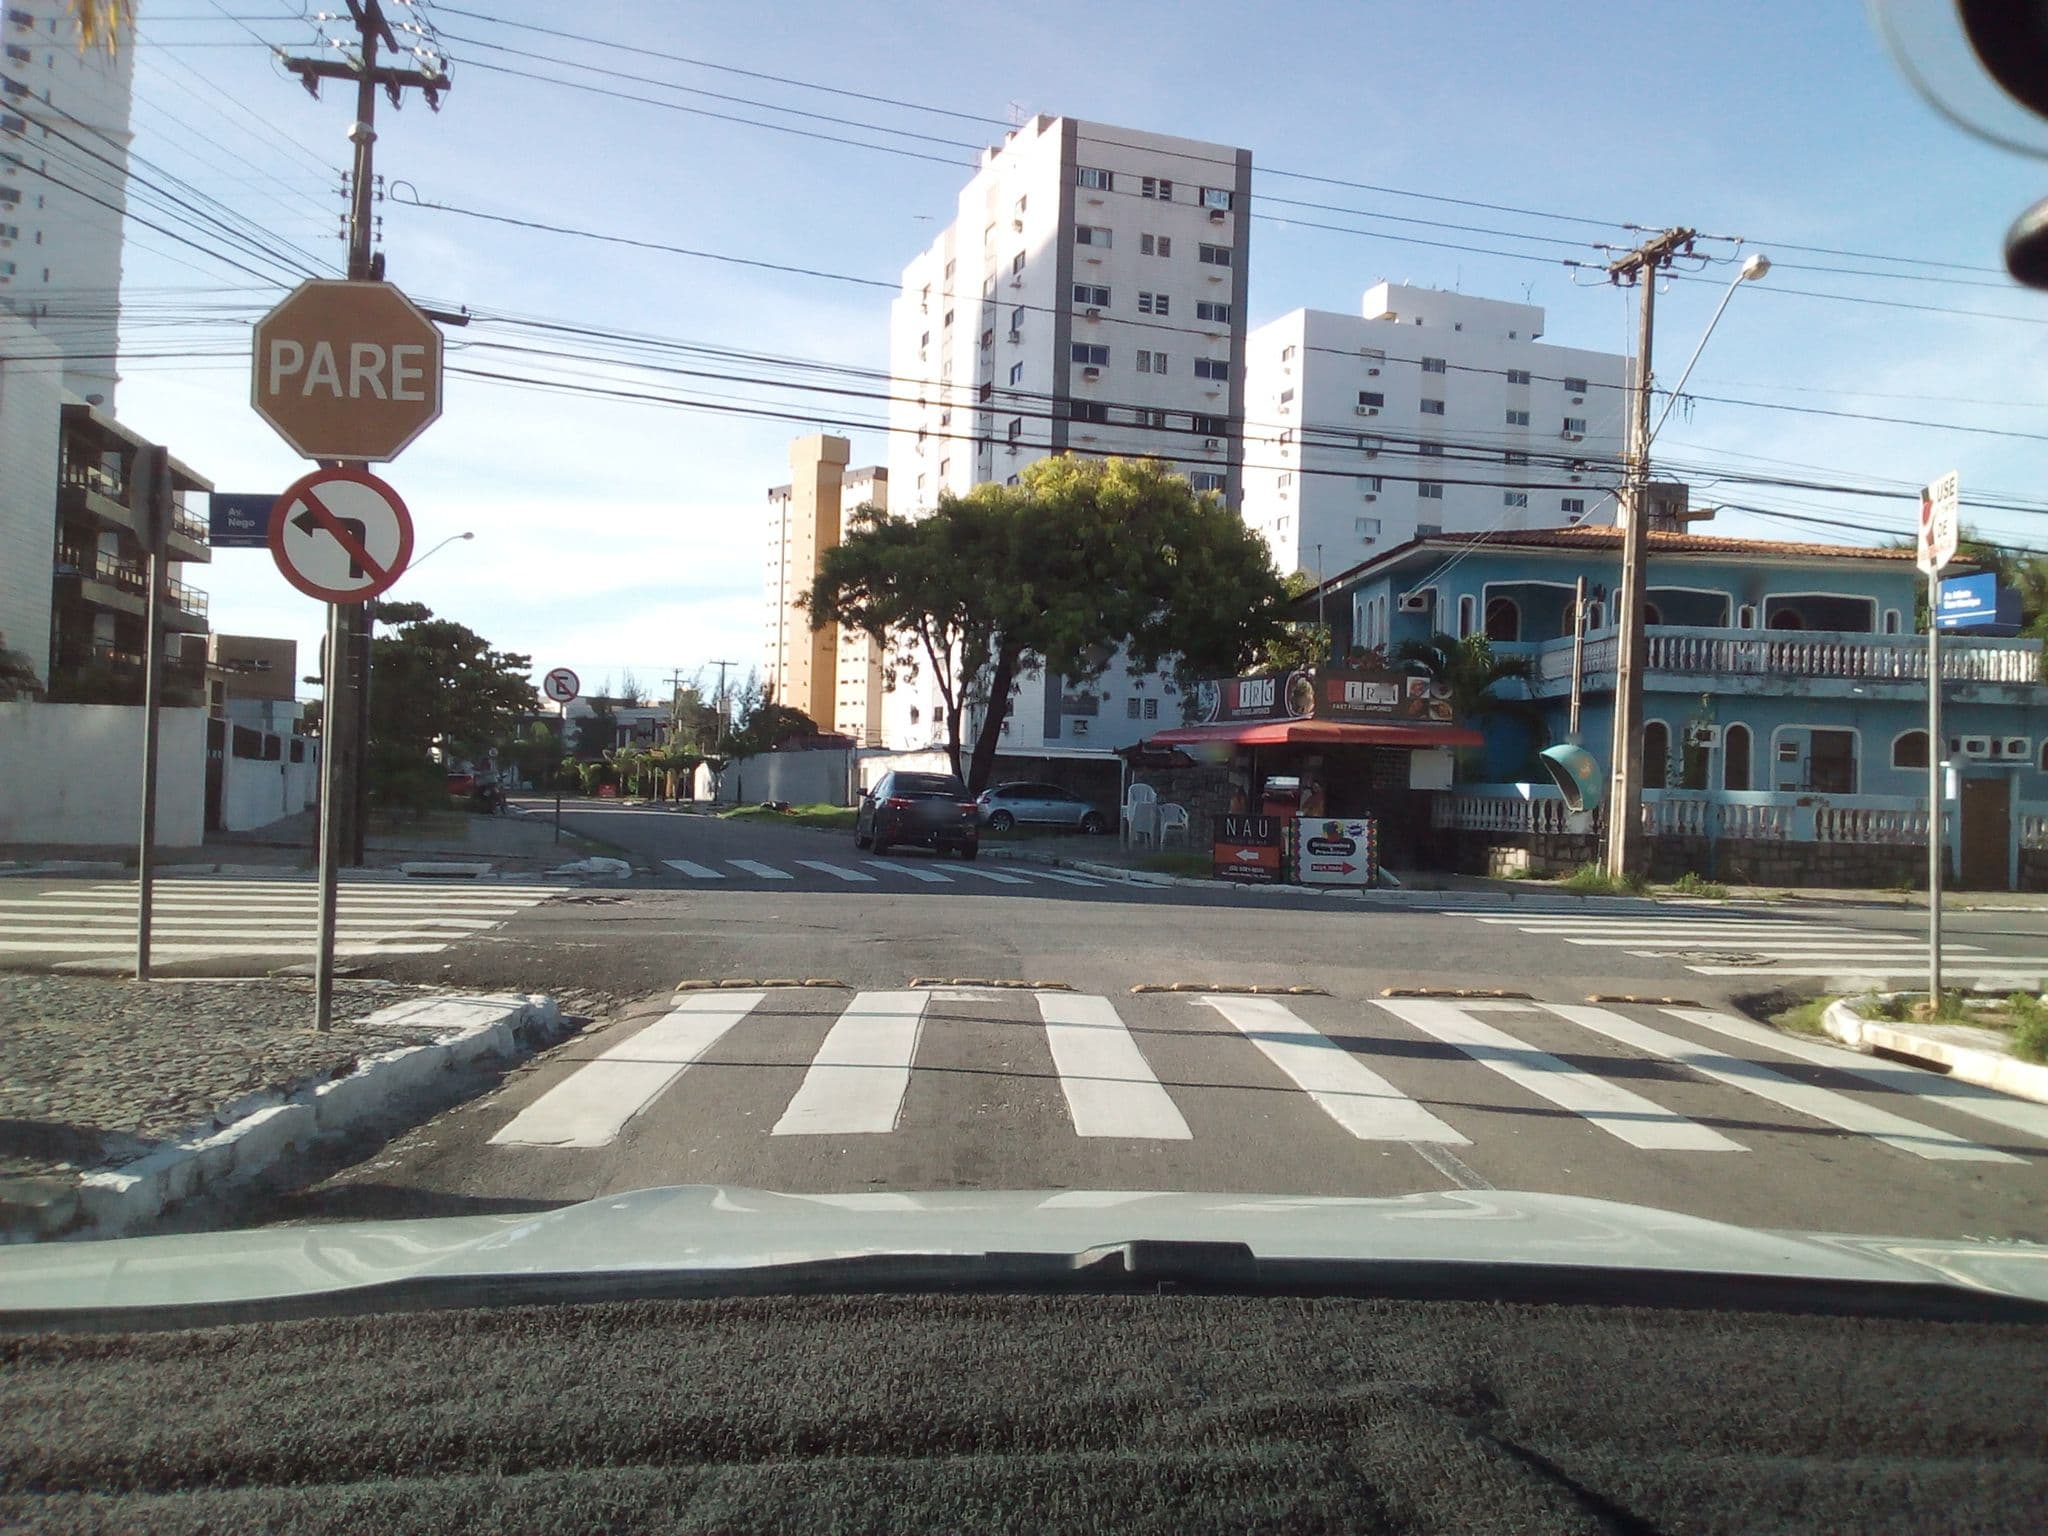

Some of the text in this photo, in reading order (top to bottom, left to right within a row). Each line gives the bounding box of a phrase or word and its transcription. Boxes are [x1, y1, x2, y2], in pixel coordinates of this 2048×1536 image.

[269, 338, 425, 401] PARE
[1937, 476, 1955, 502] USE
[228, 518, 256, 529] Nego
[1226, 817, 1268, 838] NAU
